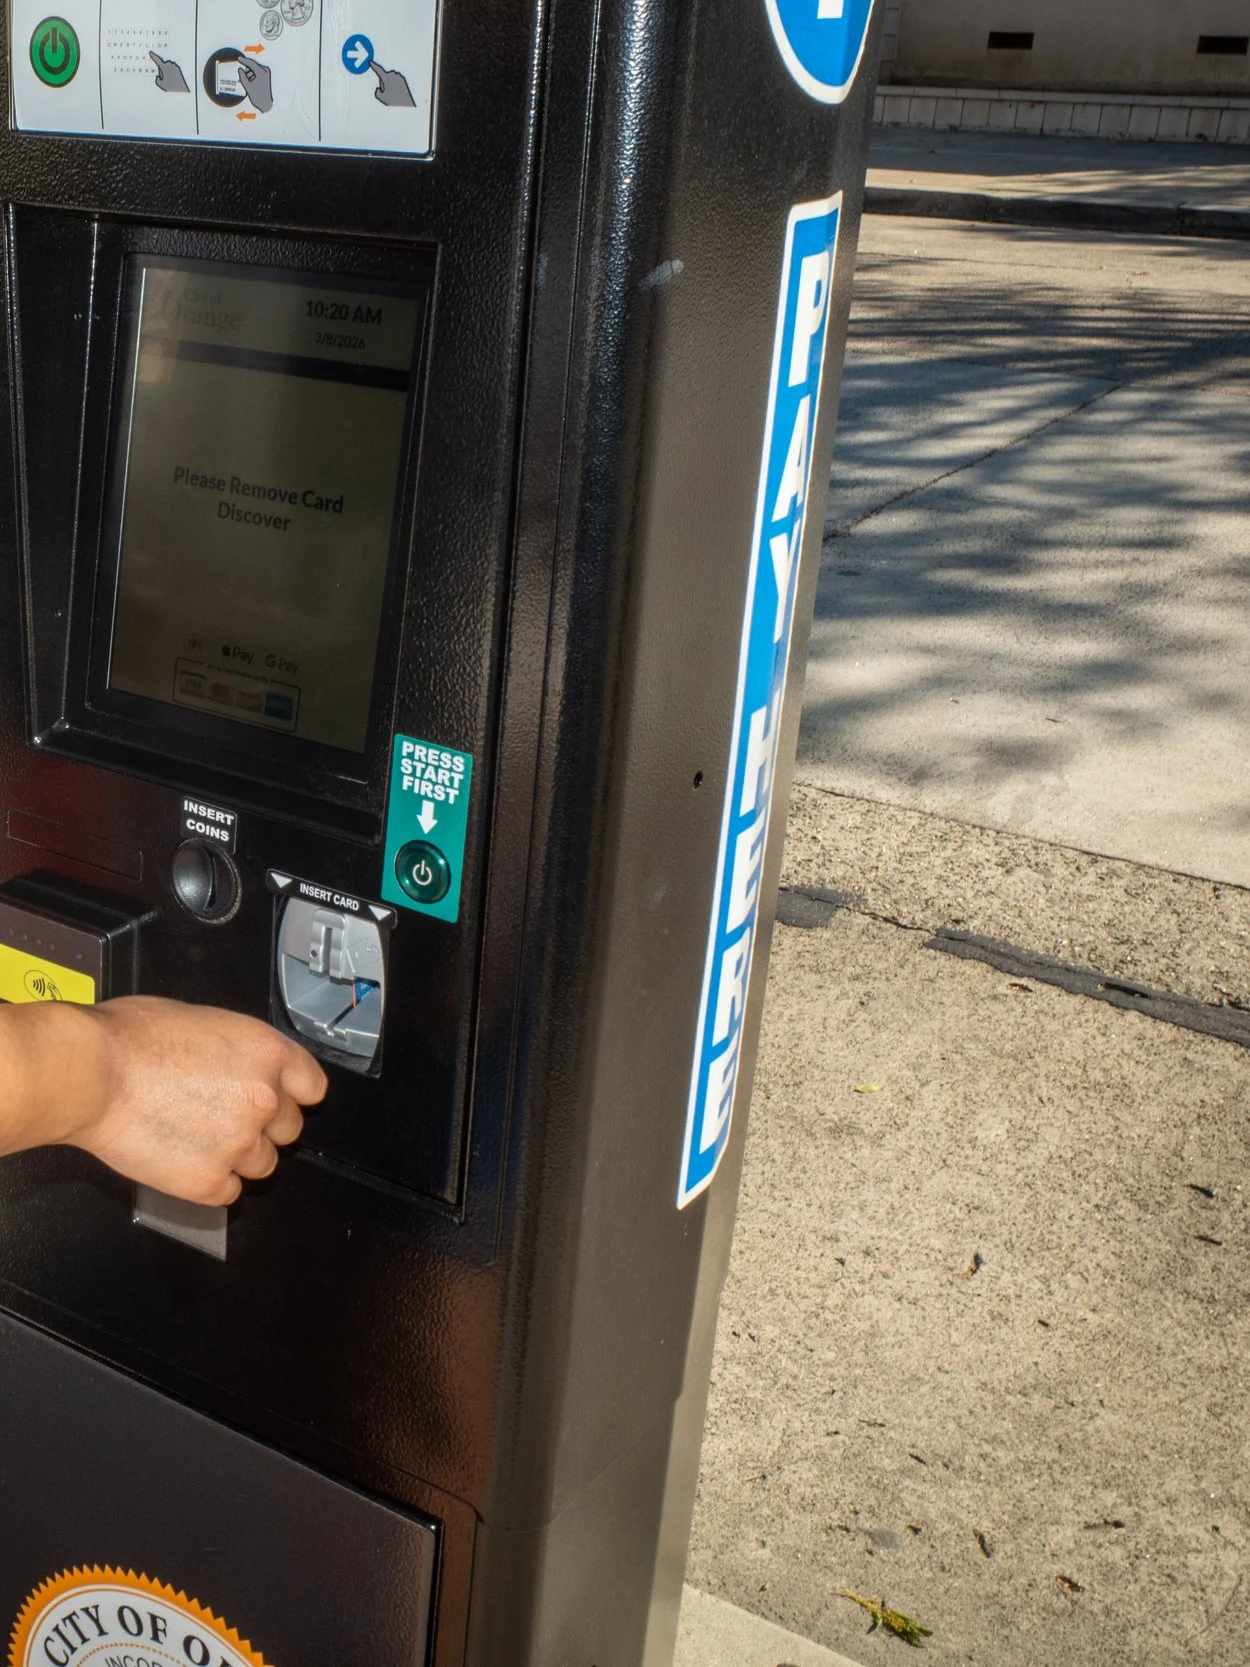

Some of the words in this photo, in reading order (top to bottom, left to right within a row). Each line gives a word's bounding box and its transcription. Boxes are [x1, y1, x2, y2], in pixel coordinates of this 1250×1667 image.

[305, 300, 350, 321] 10:20
[351, 304, 383, 326] AM
[314, 331, 367, 351] 3/8/2026
[769, 250, 831, 644] PAY
[174, 465, 226, 492] Please
[230, 476, 298, 505] Remove
[301, 490, 345, 513] Card
[217, 501, 291, 531] Discover
[232, 646, 255, 665] Pay
[278, 656, 301, 676] Pay
[402, 741, 465, 772] PRESS
[400, 758, 464, 788] START
[402, 775, 459, 804] FIRST
[184, 800, 234, 826] INSERT
[186, 819, 229, 842] COINS
[300, 883, 332, 902] INSERT
[333, 895, 359, 911] CARD
[699, 687, 781, 1155] HERE
[43, 1604, 109, 1667] CITY
[117, 1605, 168, 1645] OF
[182, 1635, 233, 1667] O
